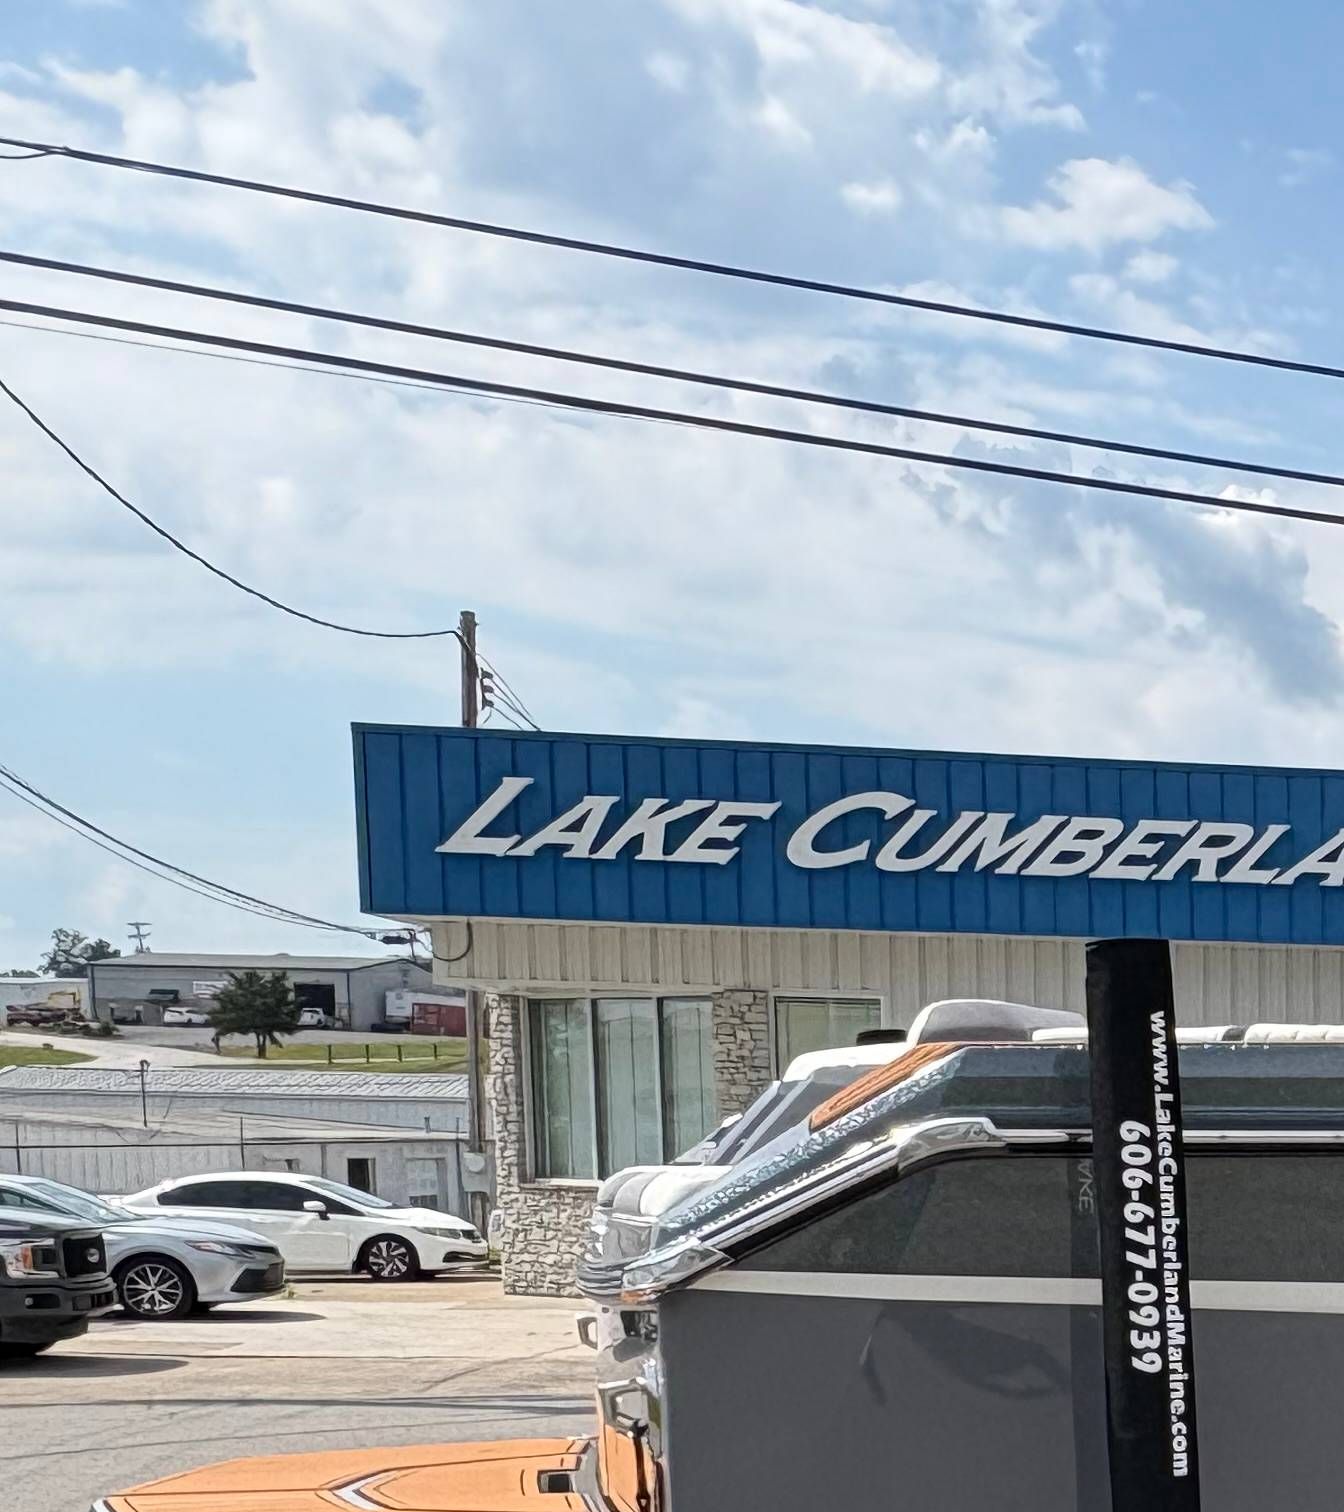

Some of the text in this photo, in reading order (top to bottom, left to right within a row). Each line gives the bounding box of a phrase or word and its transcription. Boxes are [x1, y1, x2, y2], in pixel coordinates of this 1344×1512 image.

[436, 776, 782, 866] LAKE
[1119, 1120, 1163, 1374] 606-677-0939
[1150, 1010, 1189, 1477] www.LakeCumberlandMarine.com
